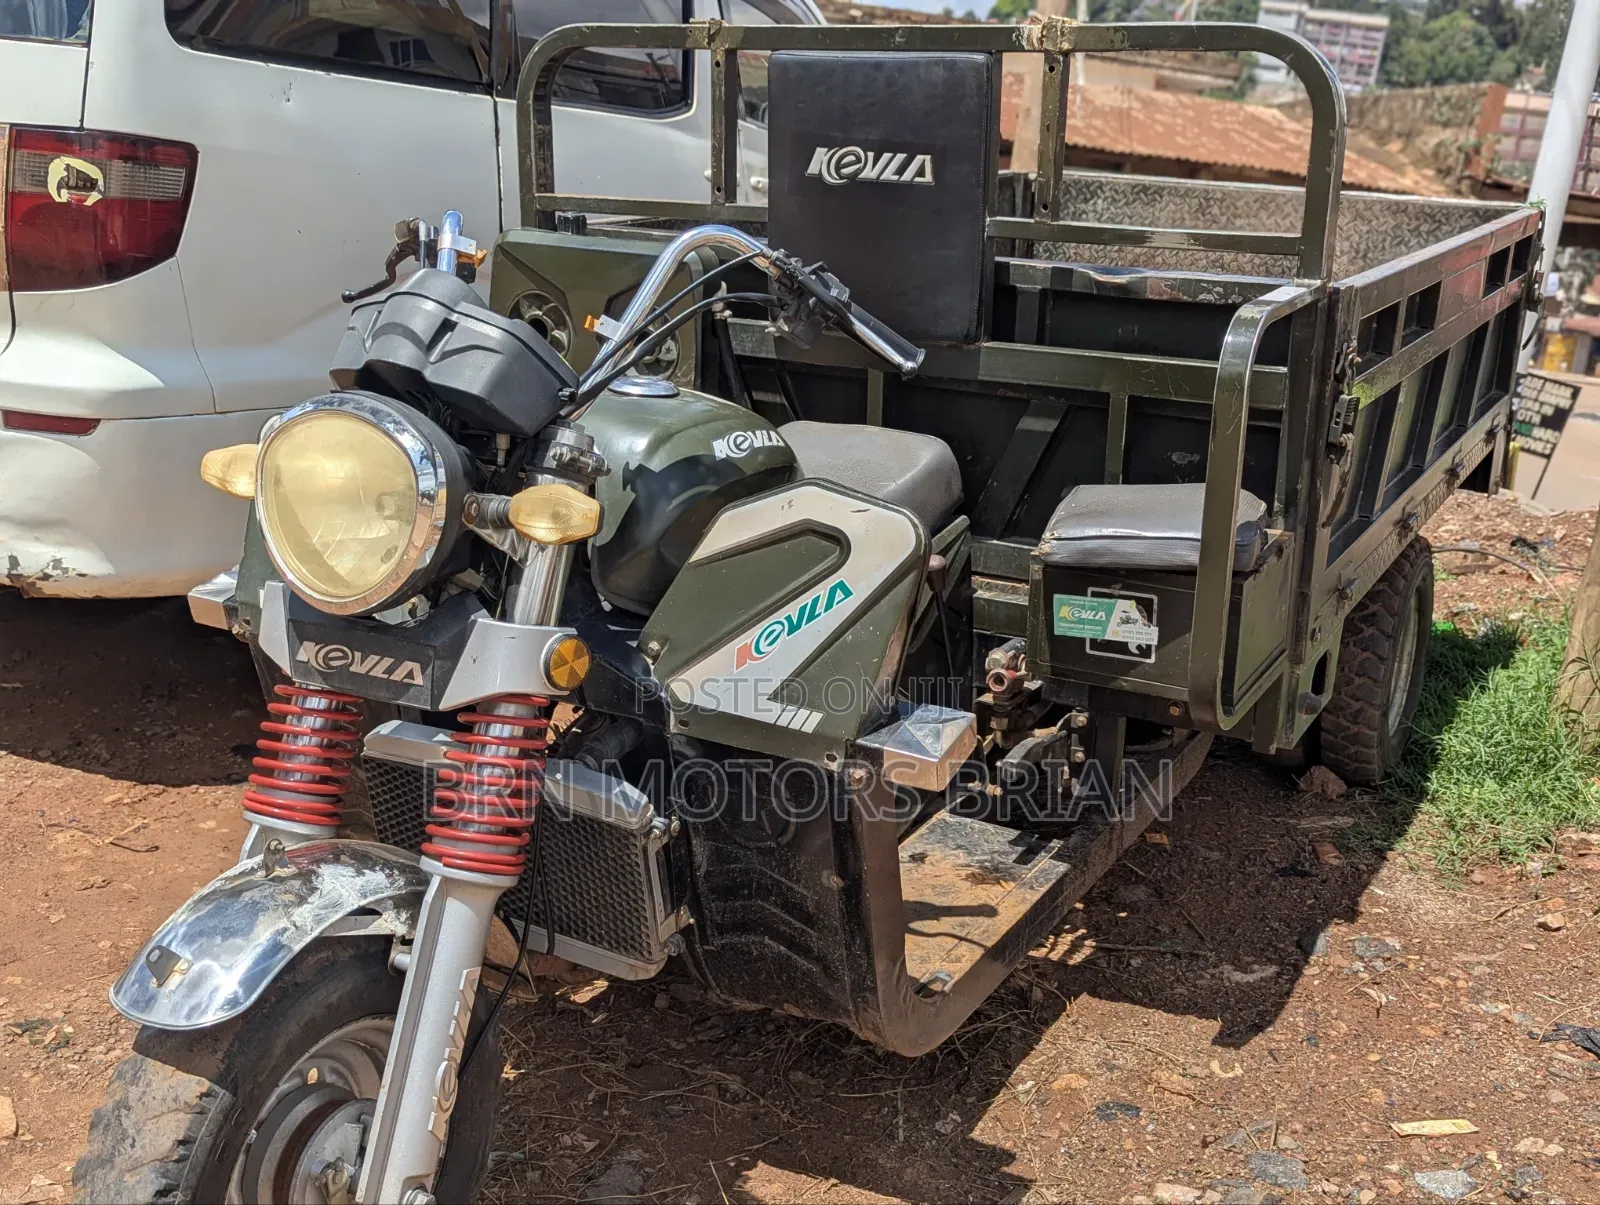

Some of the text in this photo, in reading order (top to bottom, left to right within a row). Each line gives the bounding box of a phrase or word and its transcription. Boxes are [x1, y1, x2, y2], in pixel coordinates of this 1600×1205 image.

[804, 146, 935, 185] KeVLA
[712, 429, 786, 461] KeVLA
[733, 578, 856, 674] KeVLA
[295, 640, 424, 686] KeVLA
